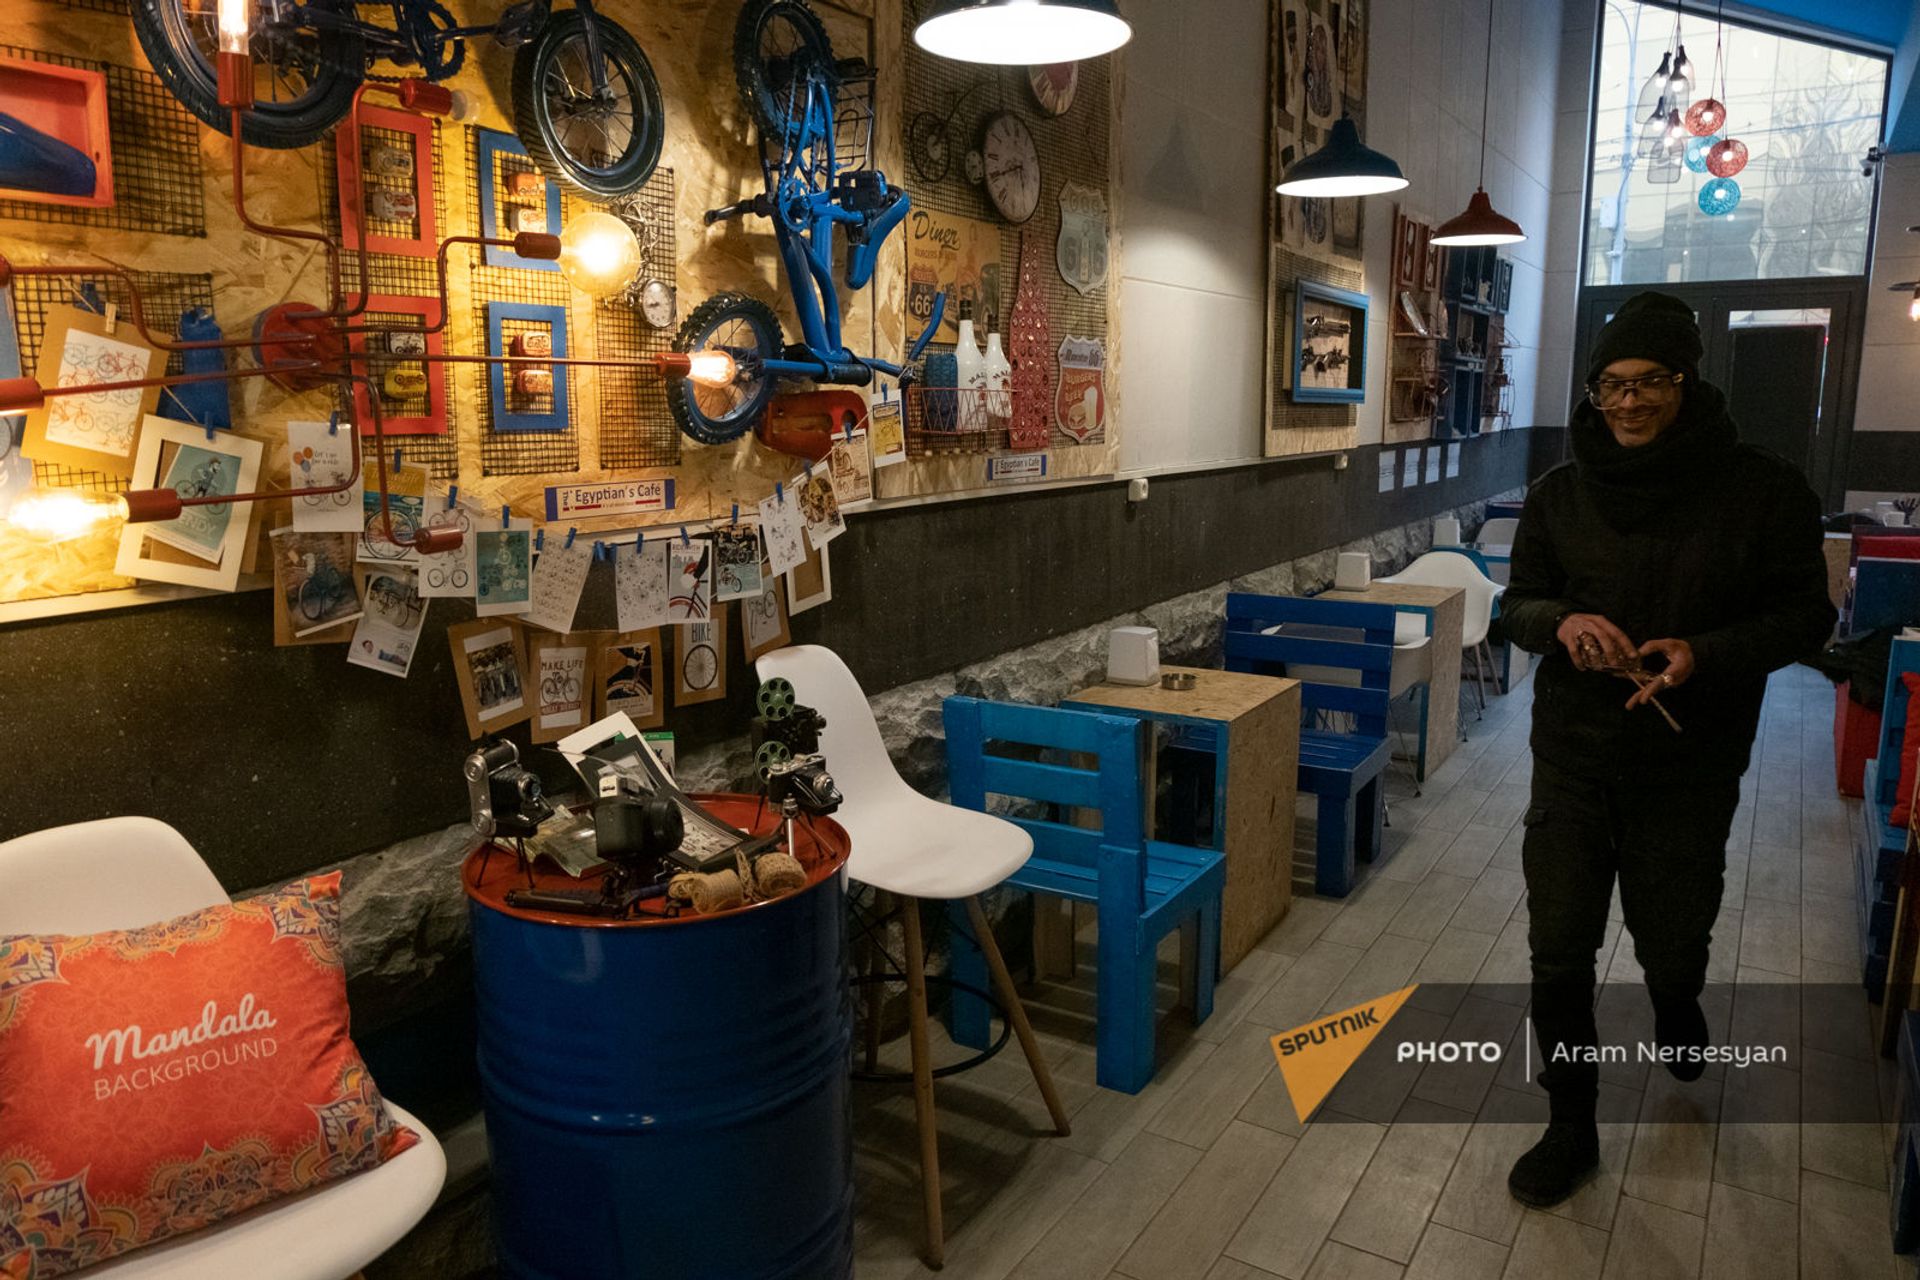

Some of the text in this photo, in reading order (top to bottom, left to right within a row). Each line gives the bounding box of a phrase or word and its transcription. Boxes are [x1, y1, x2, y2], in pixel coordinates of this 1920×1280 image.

[912, 210, 961, 251] Diner
[915, 294, 931, 316] 66
[575, 486, 635, 505] Egyptian's
[637, 483, 661, 498] Café
[691, 622, 712, 643] BIKE
[541, 659, 584, 671] MAKE LIFE
[85, 993, 277, 1070] Mandala
[94, 1037, 277, 1100] BACKGROUND
